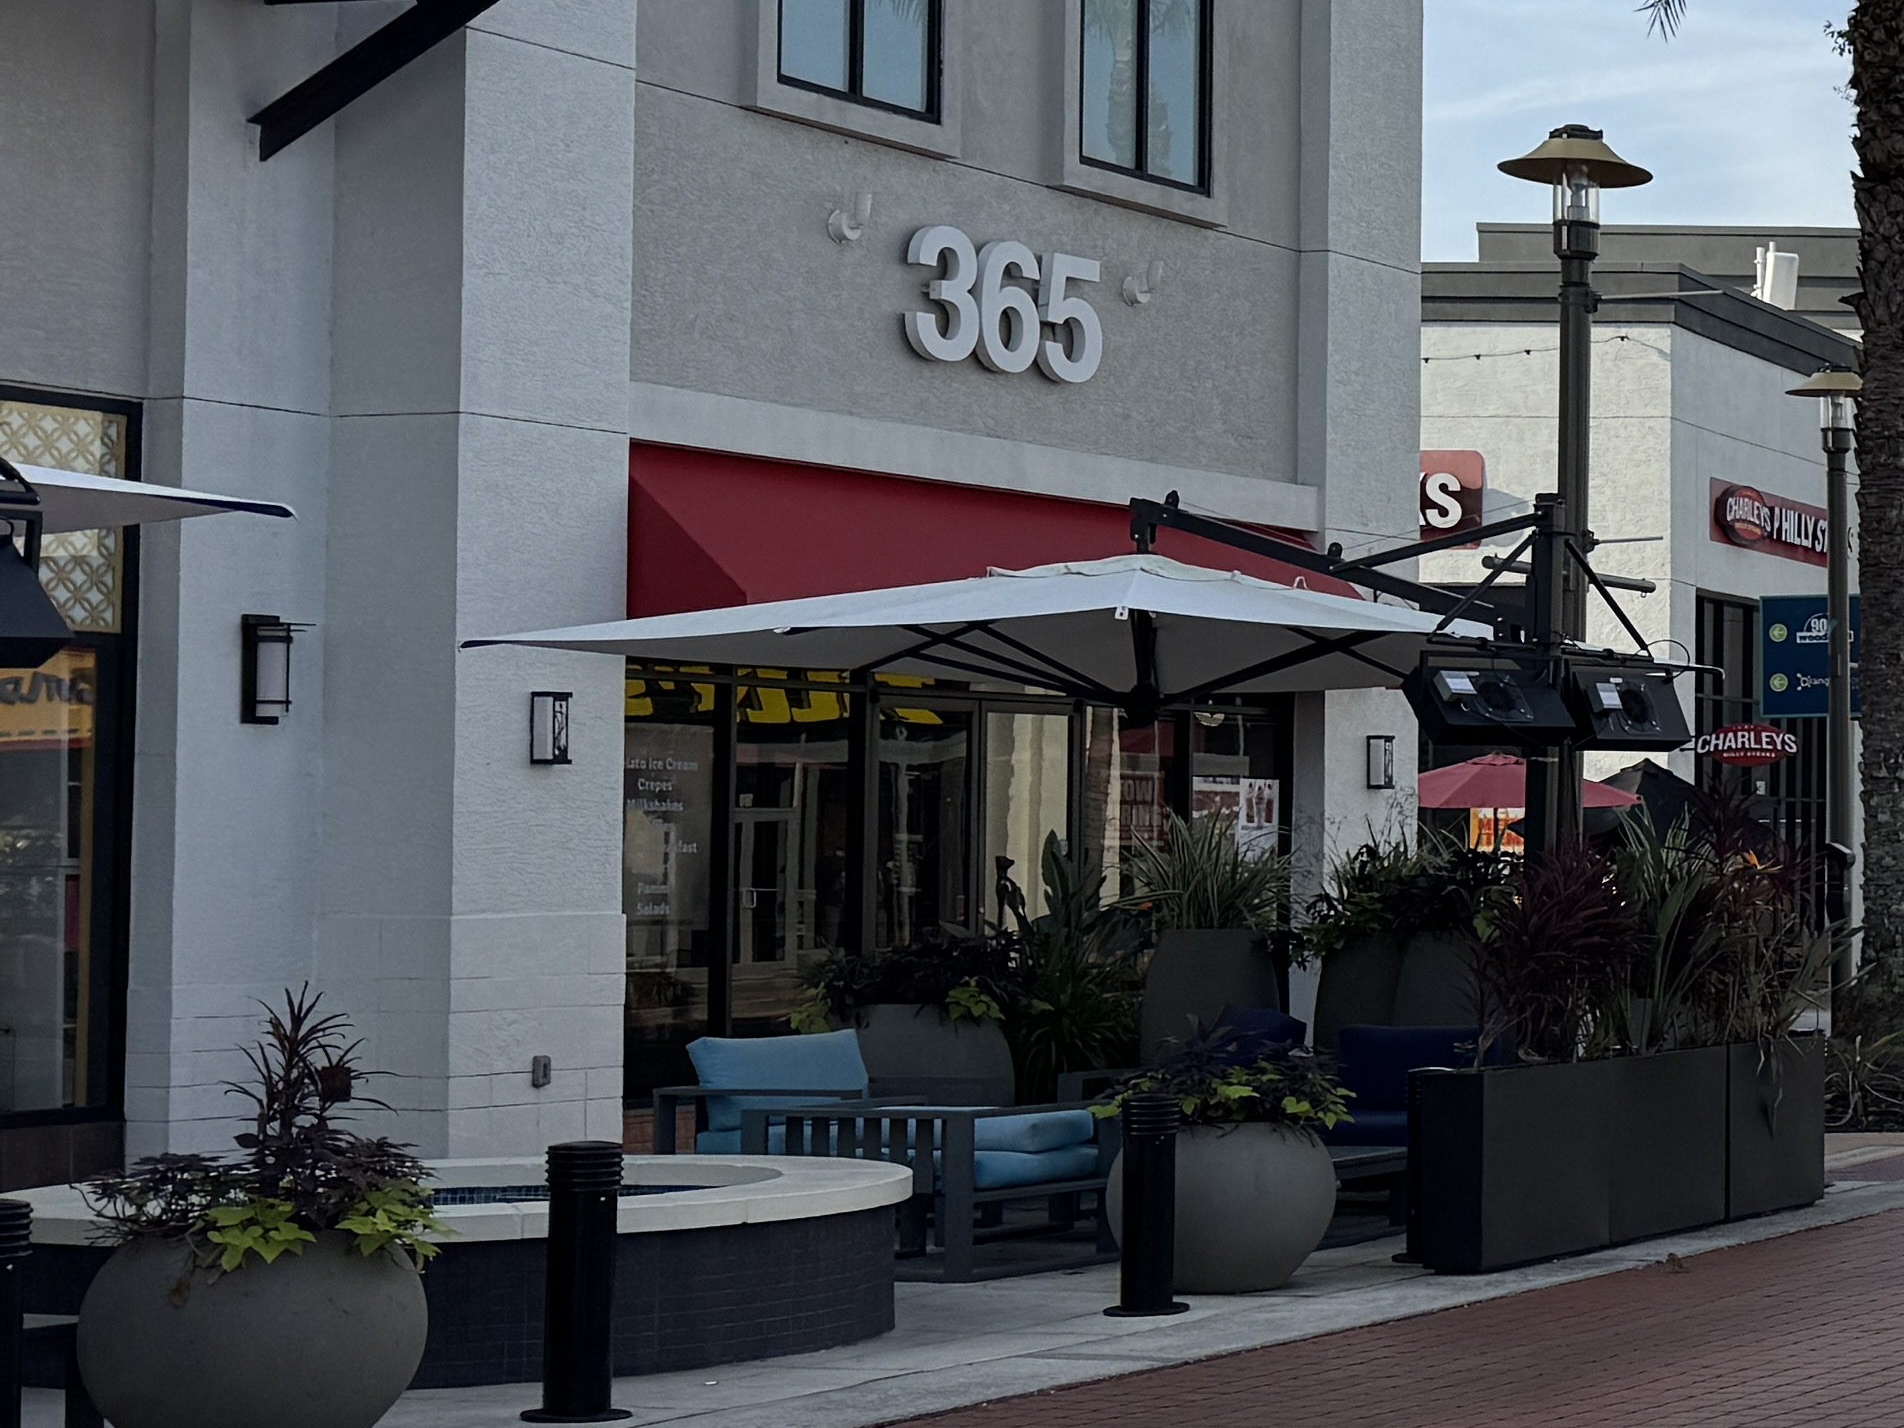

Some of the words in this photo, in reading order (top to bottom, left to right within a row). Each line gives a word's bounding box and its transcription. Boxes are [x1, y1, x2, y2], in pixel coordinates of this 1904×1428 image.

[904, 225, 1103, 384] 365
[1420, 472, 1462, 529] S
[1726, 497, 1770, 532] CHARLEYS
[1697, 732, 1798, 754] CHARLEYS
[649, 757, 663, 770] Ice
[666, 757, 698, 771] Cream
[638, 778, 672, 793] Crepes
